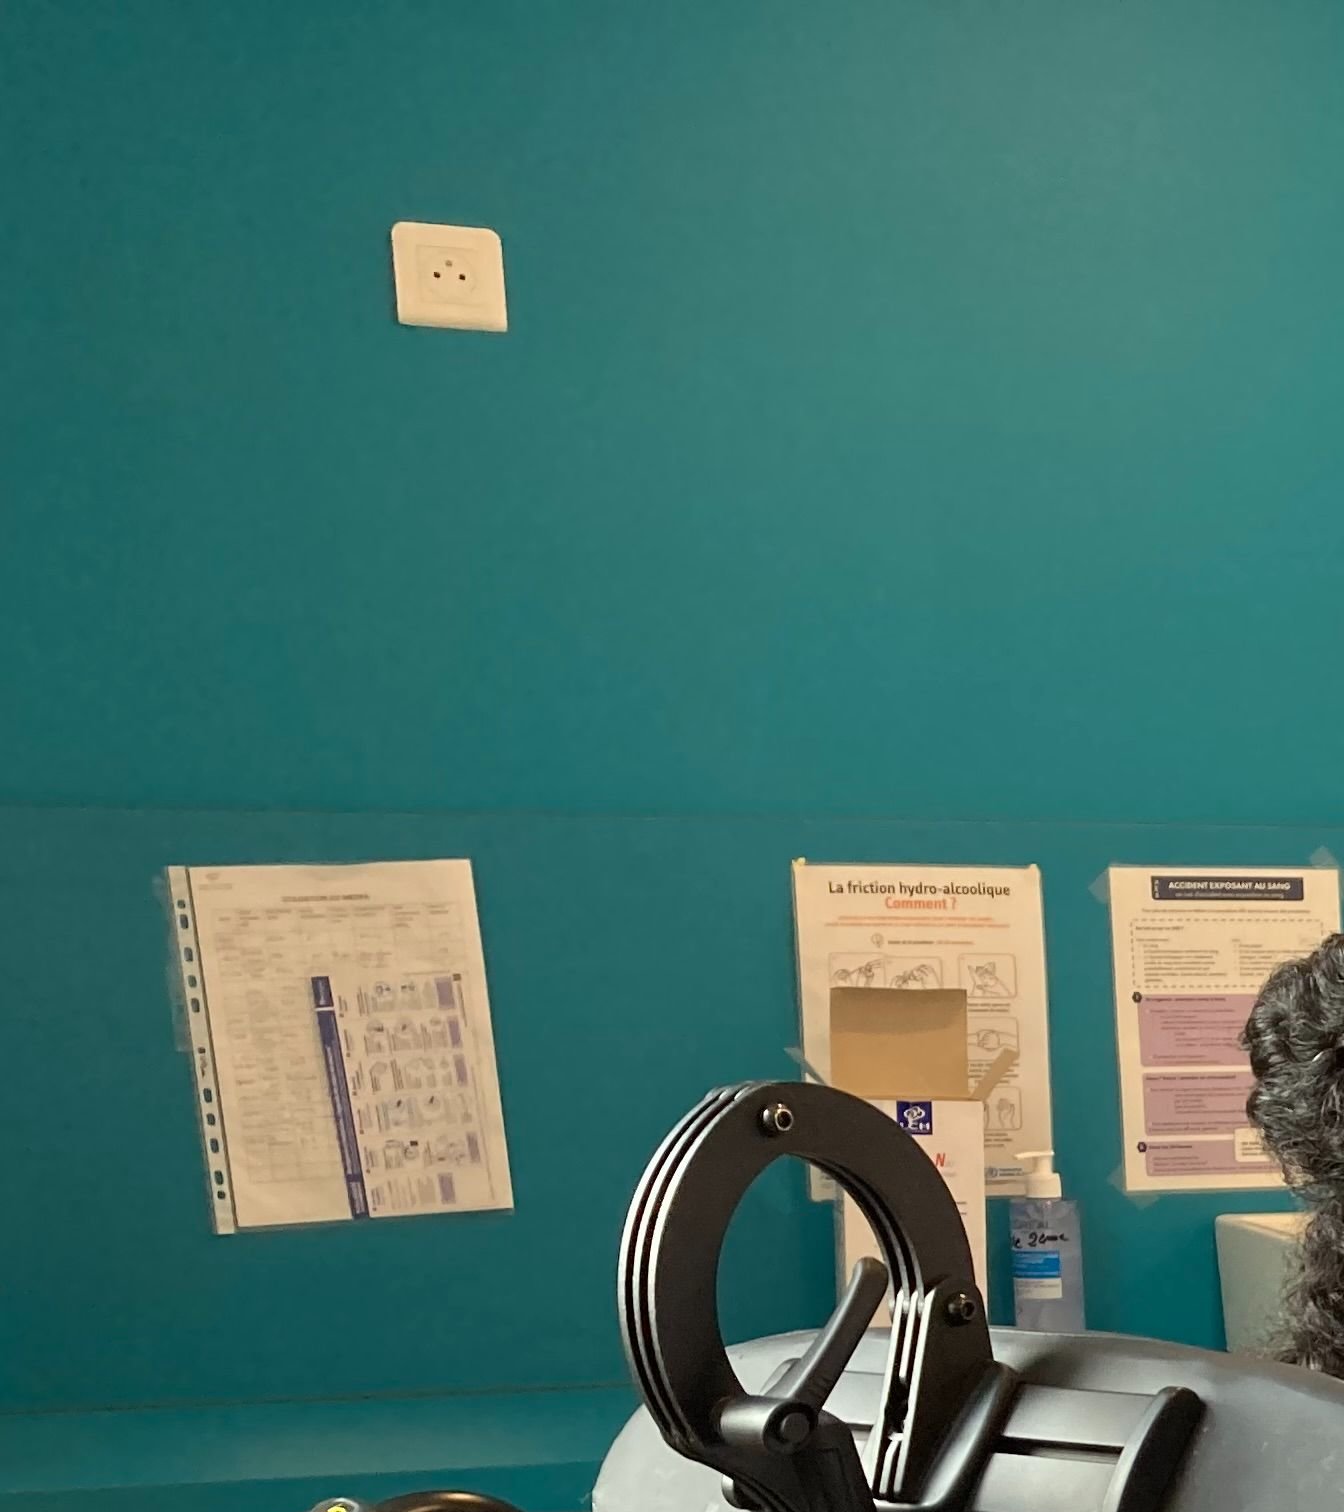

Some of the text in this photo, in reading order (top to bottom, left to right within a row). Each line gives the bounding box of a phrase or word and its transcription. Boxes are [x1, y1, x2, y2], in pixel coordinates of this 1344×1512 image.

[828, 880, 1010, 898] La friction hydro-alcoolique
[1168, 881, 1208, 890] ACCIDENT
[1209, 881, 1252, 890] EXPOSANT
[1254, 882, 1266, 890] AU
[1267, 882, 1291, 890] SANG
[885, 897, 957, 910] Comment ?
